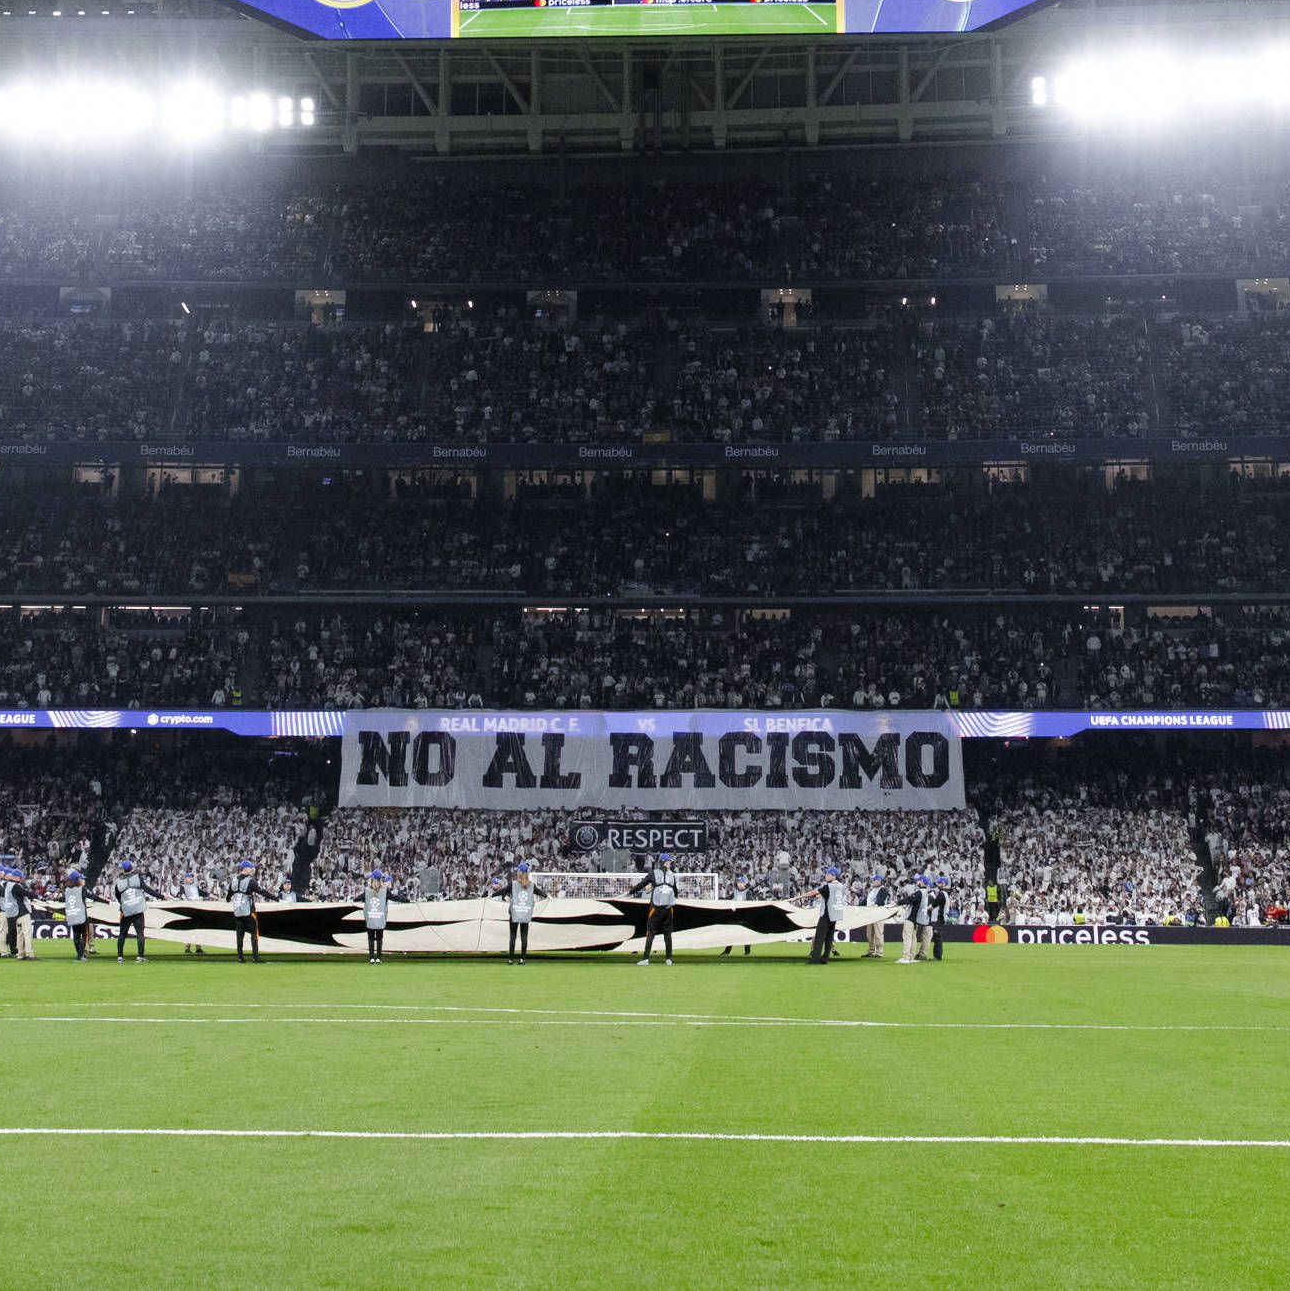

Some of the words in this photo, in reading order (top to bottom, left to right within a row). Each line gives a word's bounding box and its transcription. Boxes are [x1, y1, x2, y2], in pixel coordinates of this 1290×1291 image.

[140, 444, 195, 457] Bernabéu
[287, 445, 341, 458] Bernabéu
[433, 445, 487, 458] Bernabéu
[579, 445, 633, 458] Bernabéu
[725, 445, 780, 459] Bernabéu
[872, 443, 927, 456] Bernabéu
[1020, 441, 1076, 455] Bernabéu
[1171, 439, 1228, 453] Bernabéu
[160, 714, 214, 724] crypto.com
[440, 718, 481, 732] REAL
[484, 718, 547, 732] MADRID
[637, 718, 657, 732] VS
[744, 718, 761, 732] SL
[765, 718, 834, 732] BENFICA
[1090, 715, 1119, 726] UEFA
[1120, 715, 1188, 726] CHAMPIONS
[1189, 715, 1233, 726] LEAGUE
[356, 730, 457, 788] NO
[482, 732, 582, 790] AL
[608, 731, 950, 790] RACISMO
[608, 829, 703, 848] RESPECT
[1017, 925, 1151, 946] priceless
